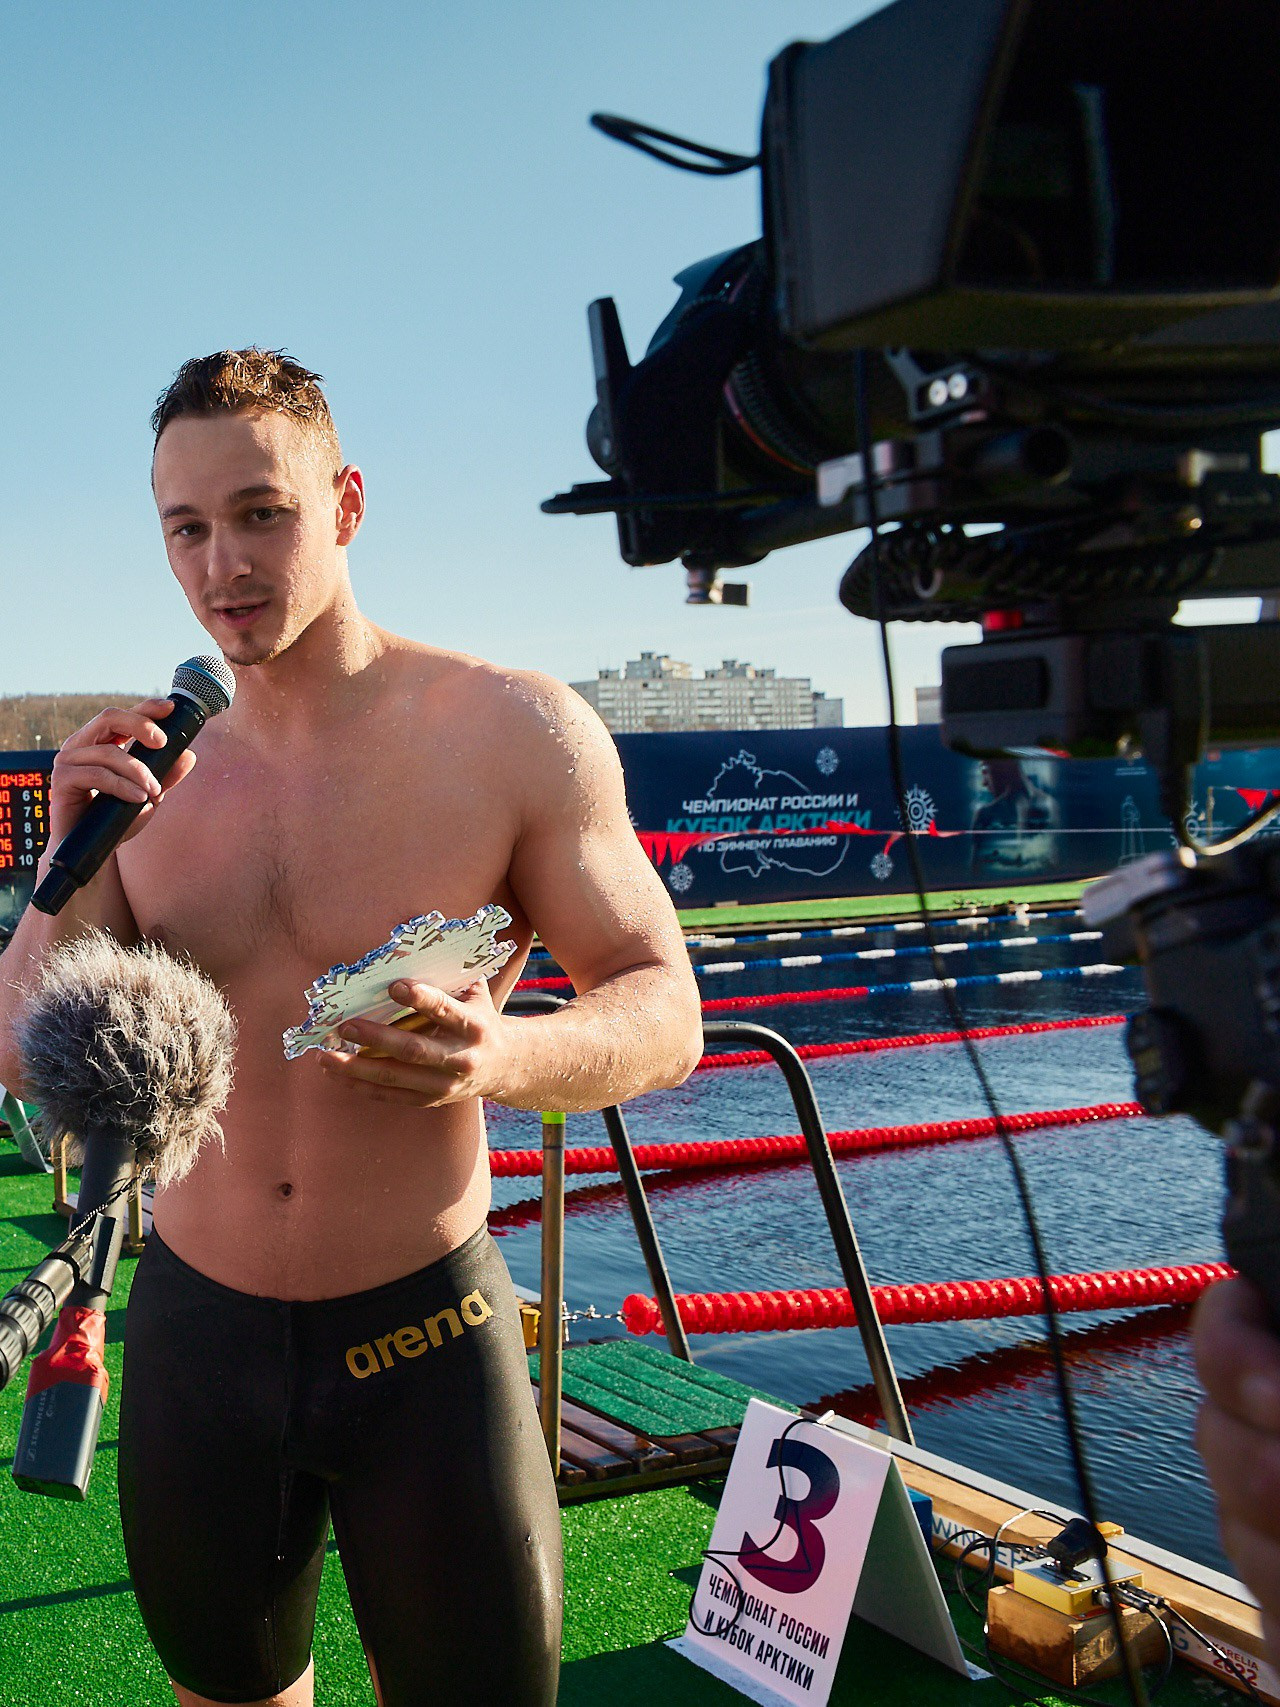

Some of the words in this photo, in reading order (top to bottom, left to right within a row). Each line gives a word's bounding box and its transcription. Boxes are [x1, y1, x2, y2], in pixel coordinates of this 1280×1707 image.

[22, 790, 30, 801] 6
[33, 789, 43, 802] 4
[682, 797, 778, 814] ЧЕМПИОНАТ
[780, 794, 844, 810] РОССИИ
[846, 793, 859, 807] И
[23, 806, 31, 818] 7
[34, 804, 43, 818] 6
[24, 822, 32, 834] 8
[666, 815, 754, 833] КУБОК
[25, 838, 33, 850] 9
[717, 839, 772, 852] ЗИМНЕМУ
[773, 835, 838, 849] ПЛАВАНИЮ
[19, 854, 33, 866] 10
[345, 1289, 494, 1379] arena
[738, 1438, 841, 1594] 3
[778, 1612, 830, 1660] РОССИИ
[703, 1609, 715, 1632] И
[716, 1615, 755, 1656] КУБОК
[755, 1639, 814, 1691] АРКТИКИ
